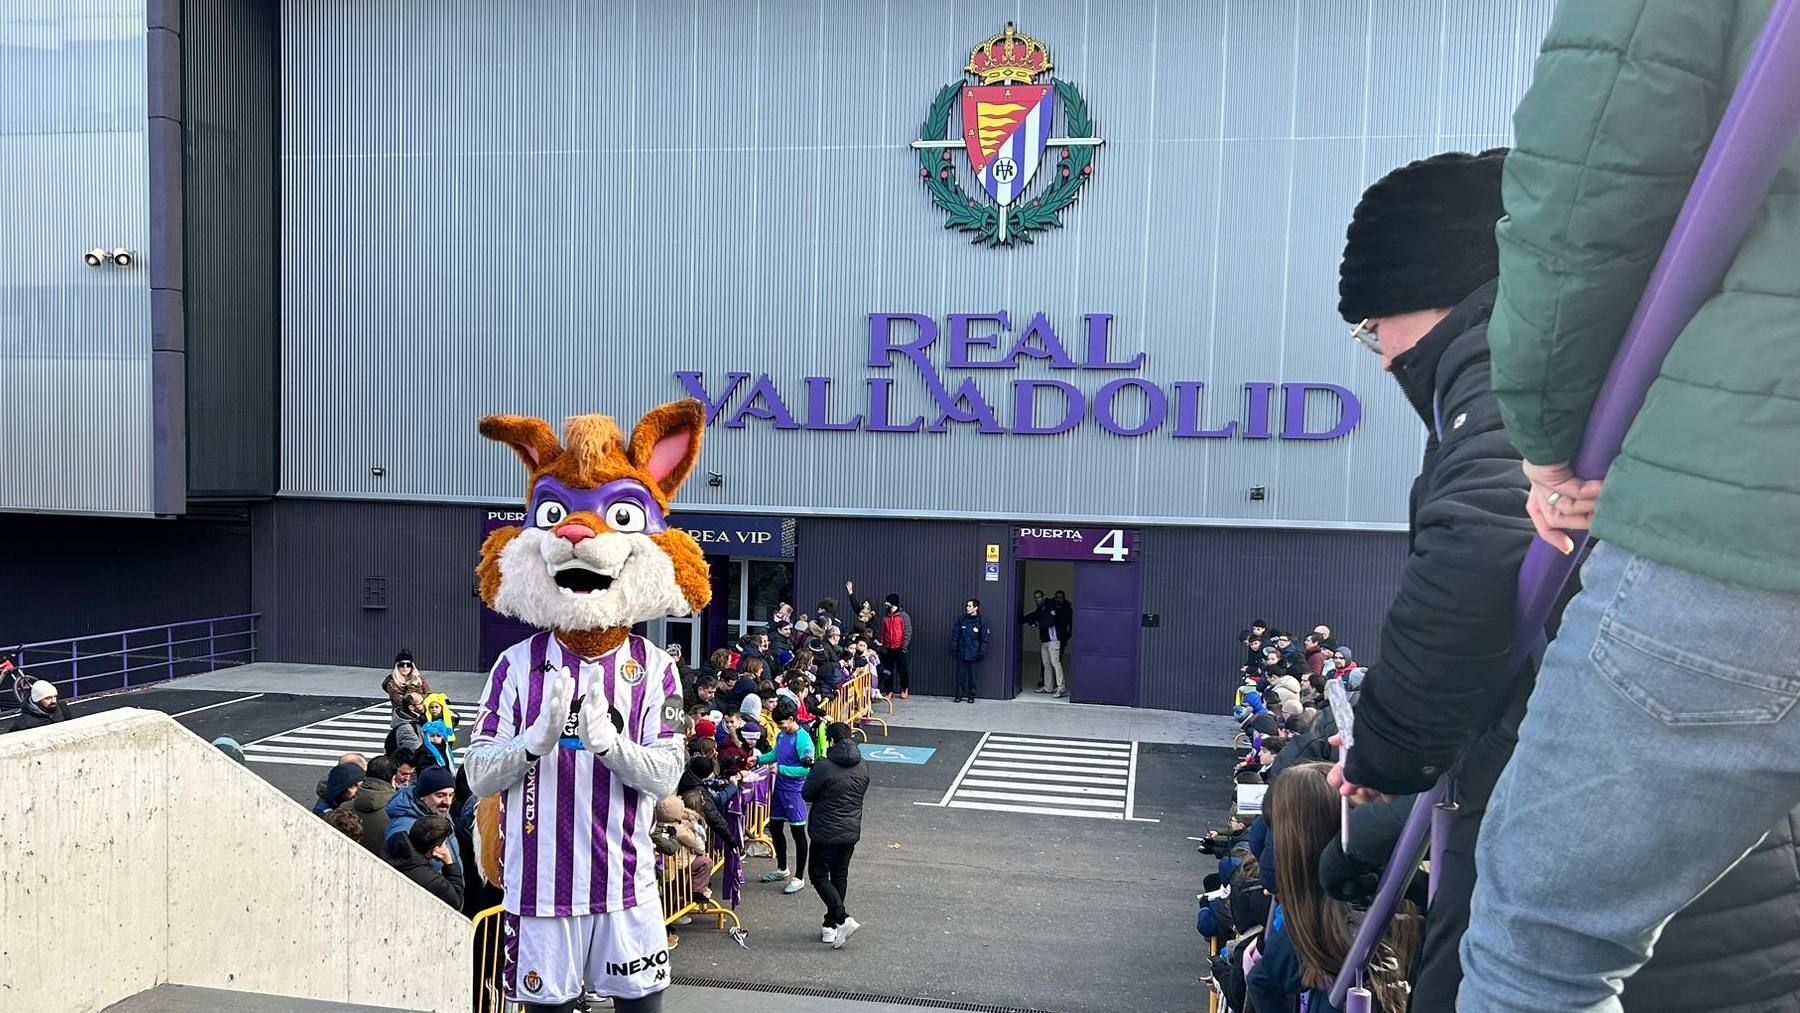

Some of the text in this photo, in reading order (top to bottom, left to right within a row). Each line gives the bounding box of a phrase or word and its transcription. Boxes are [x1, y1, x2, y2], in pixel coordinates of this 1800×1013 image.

[867, 309, 1146, 397] REAL
[673, 371, 1361, 440] VALLADOLID
[488, 511, 528, 521] PUER
[688, 529, 772, 544] REA VIP
[1020, 528, 1129, 562] PUERTA 4
[606, 950, 668, 976] INEXO
